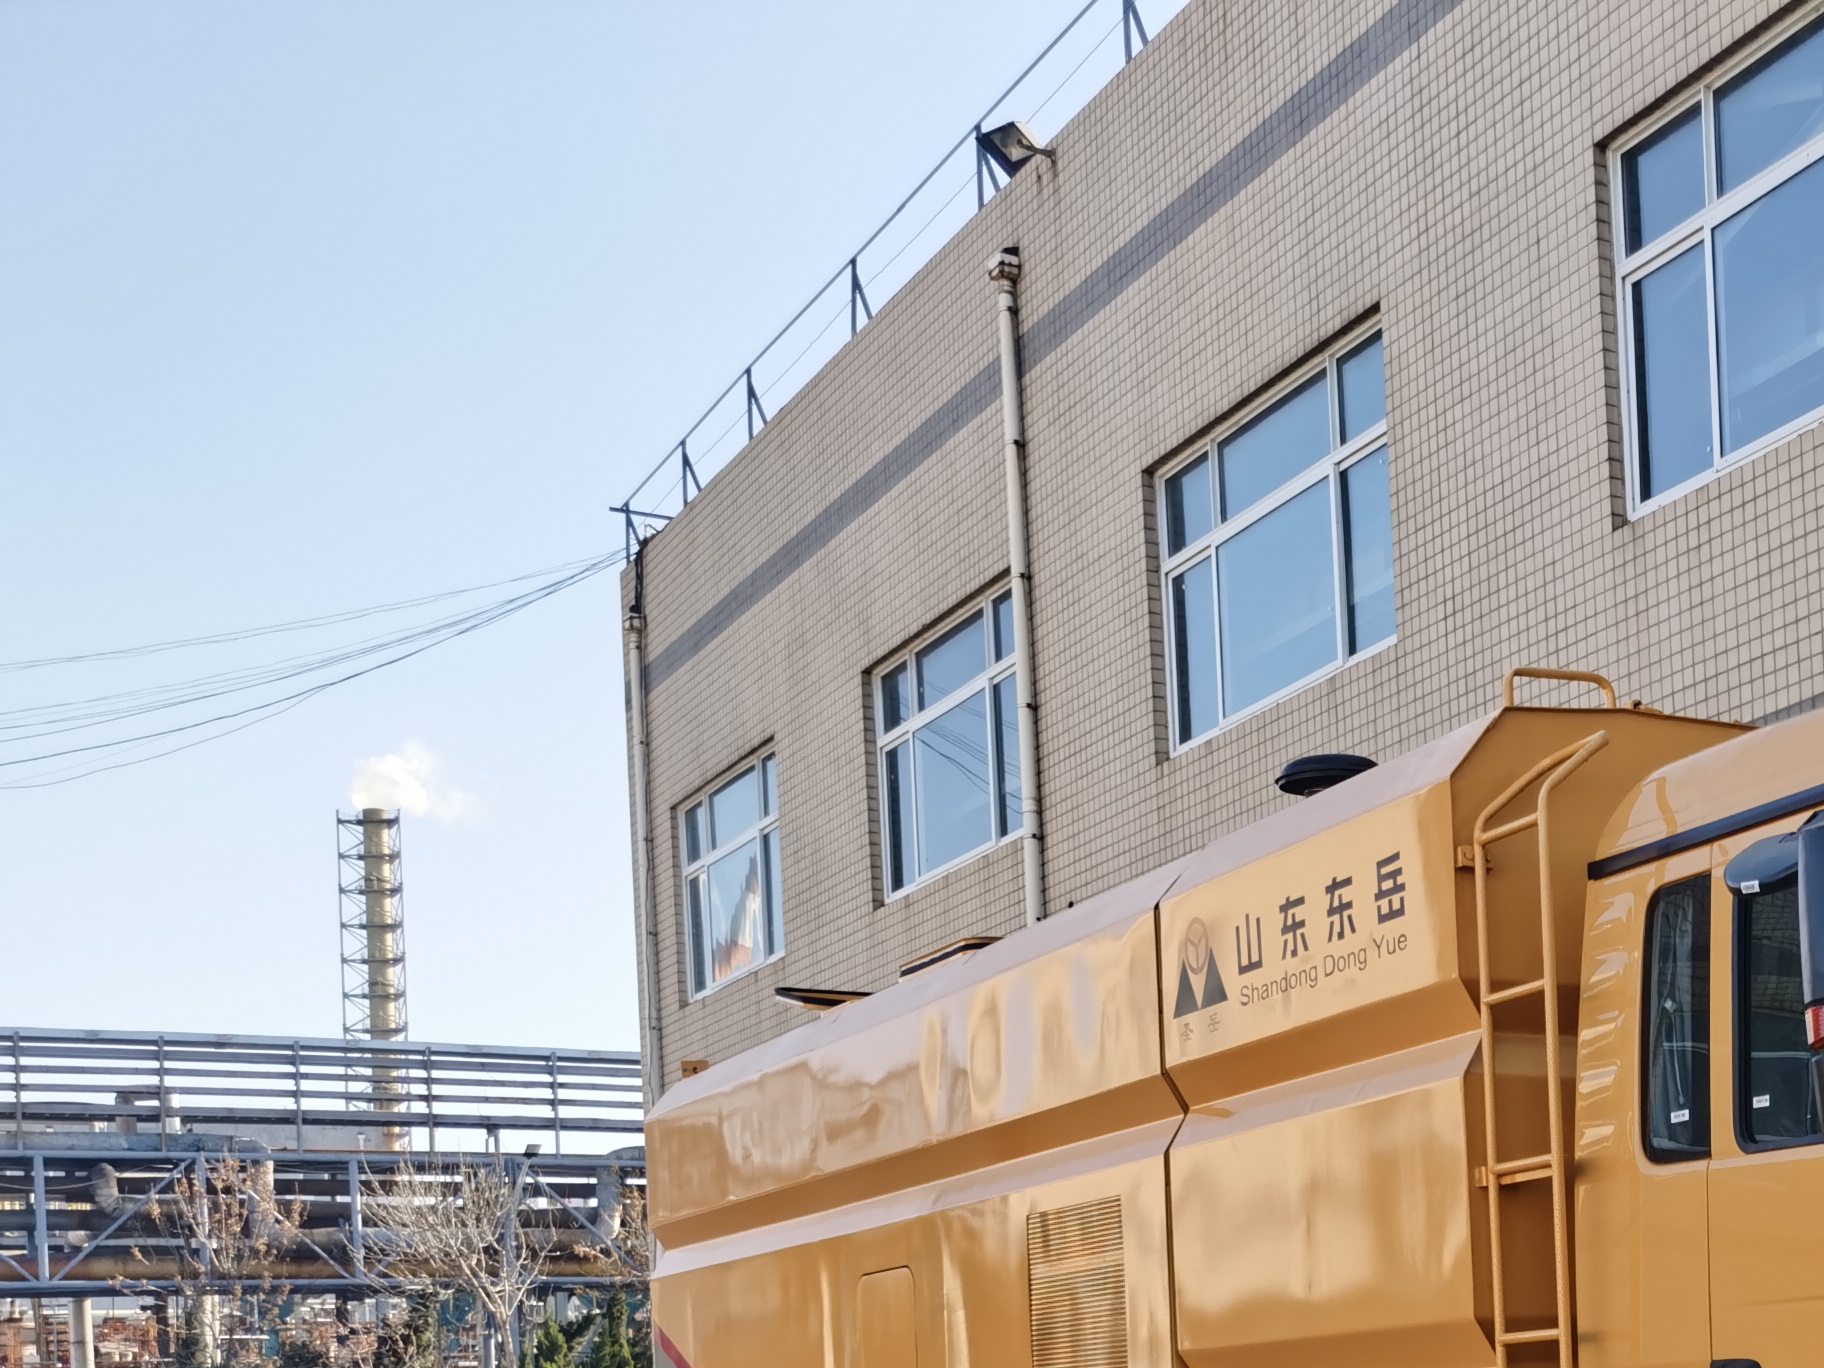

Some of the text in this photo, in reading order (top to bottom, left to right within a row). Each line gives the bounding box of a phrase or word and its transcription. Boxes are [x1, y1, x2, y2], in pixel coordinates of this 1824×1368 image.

[1235, 850, 1406, 976] 山东东岳
[1240, 932, 1408, 1007] Shandong Dong Yue
